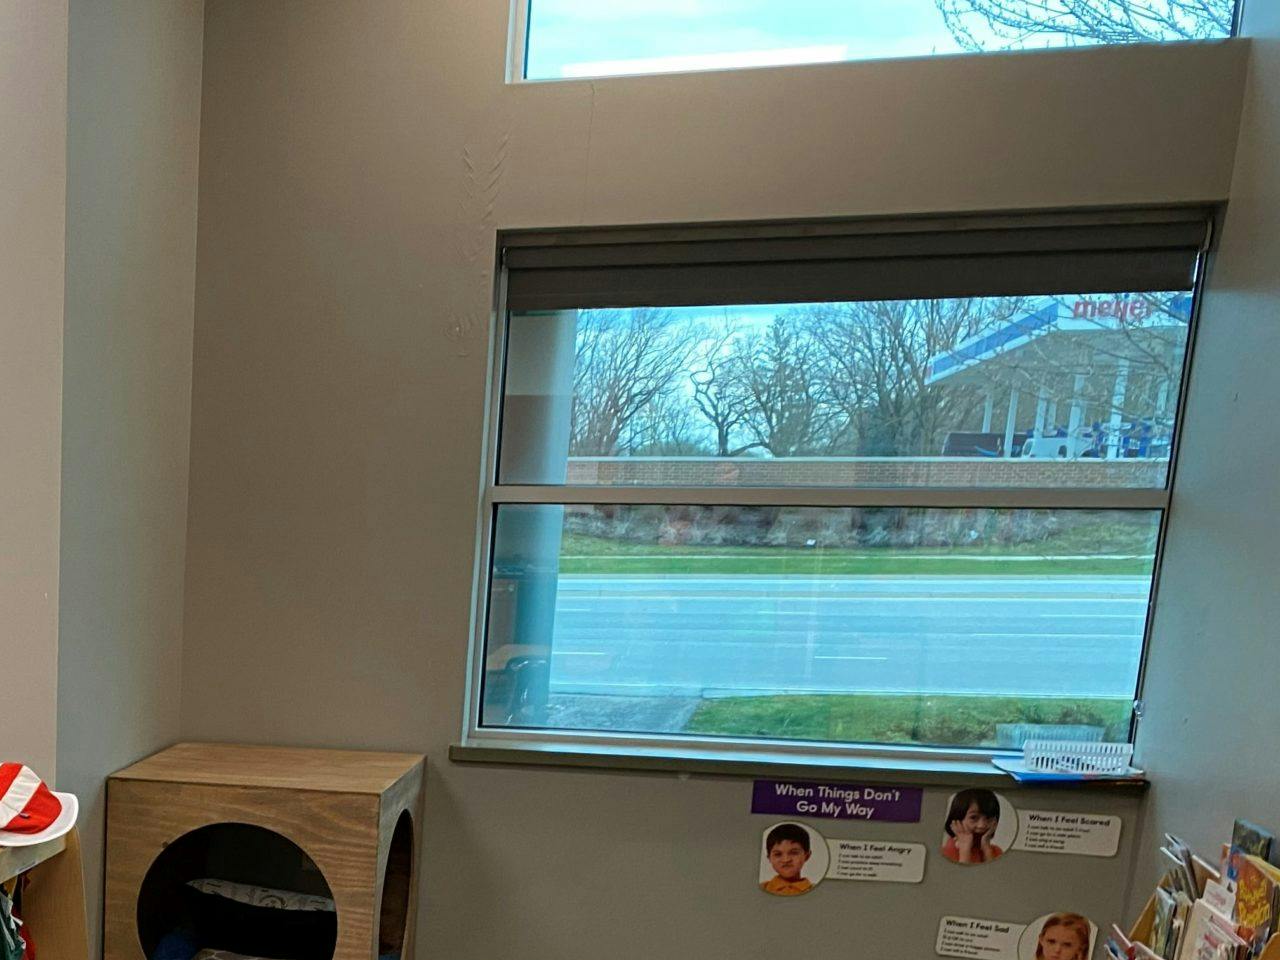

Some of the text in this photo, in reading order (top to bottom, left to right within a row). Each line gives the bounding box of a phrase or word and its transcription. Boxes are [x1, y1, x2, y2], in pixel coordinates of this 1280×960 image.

[775, 784, 901, 803] When Things Don't
[796, 801, 875, 819] Go My Way
[1029, 814, 1053, 823] When
[840, 842, 862, 851] When
[946, 919, 968, 928] When
